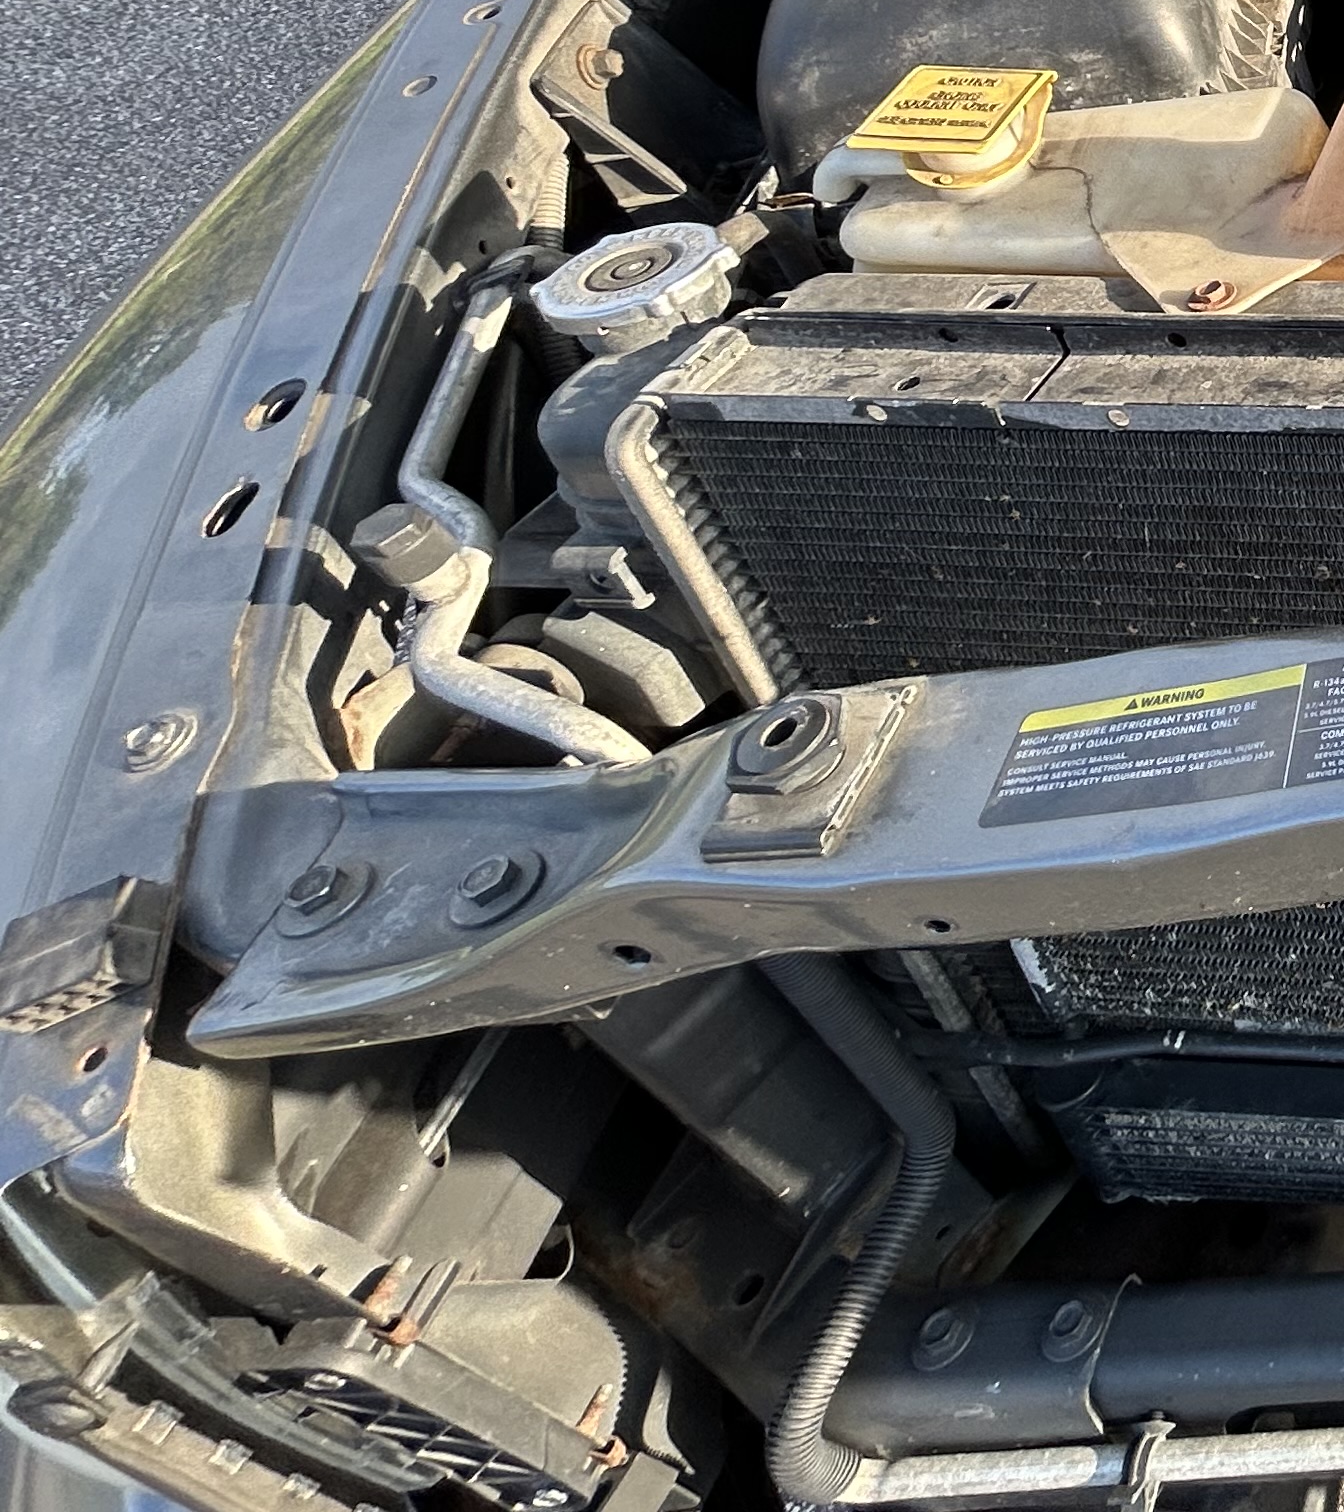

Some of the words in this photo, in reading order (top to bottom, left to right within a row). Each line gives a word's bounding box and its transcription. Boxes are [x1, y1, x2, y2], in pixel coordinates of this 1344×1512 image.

[1140, 688, 1205, 707] WARNING
[1108, 713, 1183, 735] REFRIGERANT
[1184, 706, 1227, 722] SYSTEM
[1227, 704, 1242, 714] TO
[1243, 700, 1258, 710] BE
[1014, 742, 1068, 761] SERVICED
[1069, 741, 1086, 752] BY
[1086, 732, 1144, 750] QUALIFIED
[1144, 723, 1209, 741] PERSONNEL
[997, 784, 1034, 798] SYSTEM
[1067, 775, 1101, 788] SAFETY
[1188, 761, 1206, 773] SAE
[1206, 753, 1254, 769] STANDARD
[1001, 774, 1050, 788] IMPROPER
[1050, 767, 1087, 780] SERVICE
[1134, 758, 1155, 768] MAY
[1156, 753, 1186, 766] CAUSE
[1187, 747, 1233, 761] PERSONAL
[1050, 758, 1087, 770] SERVICE
